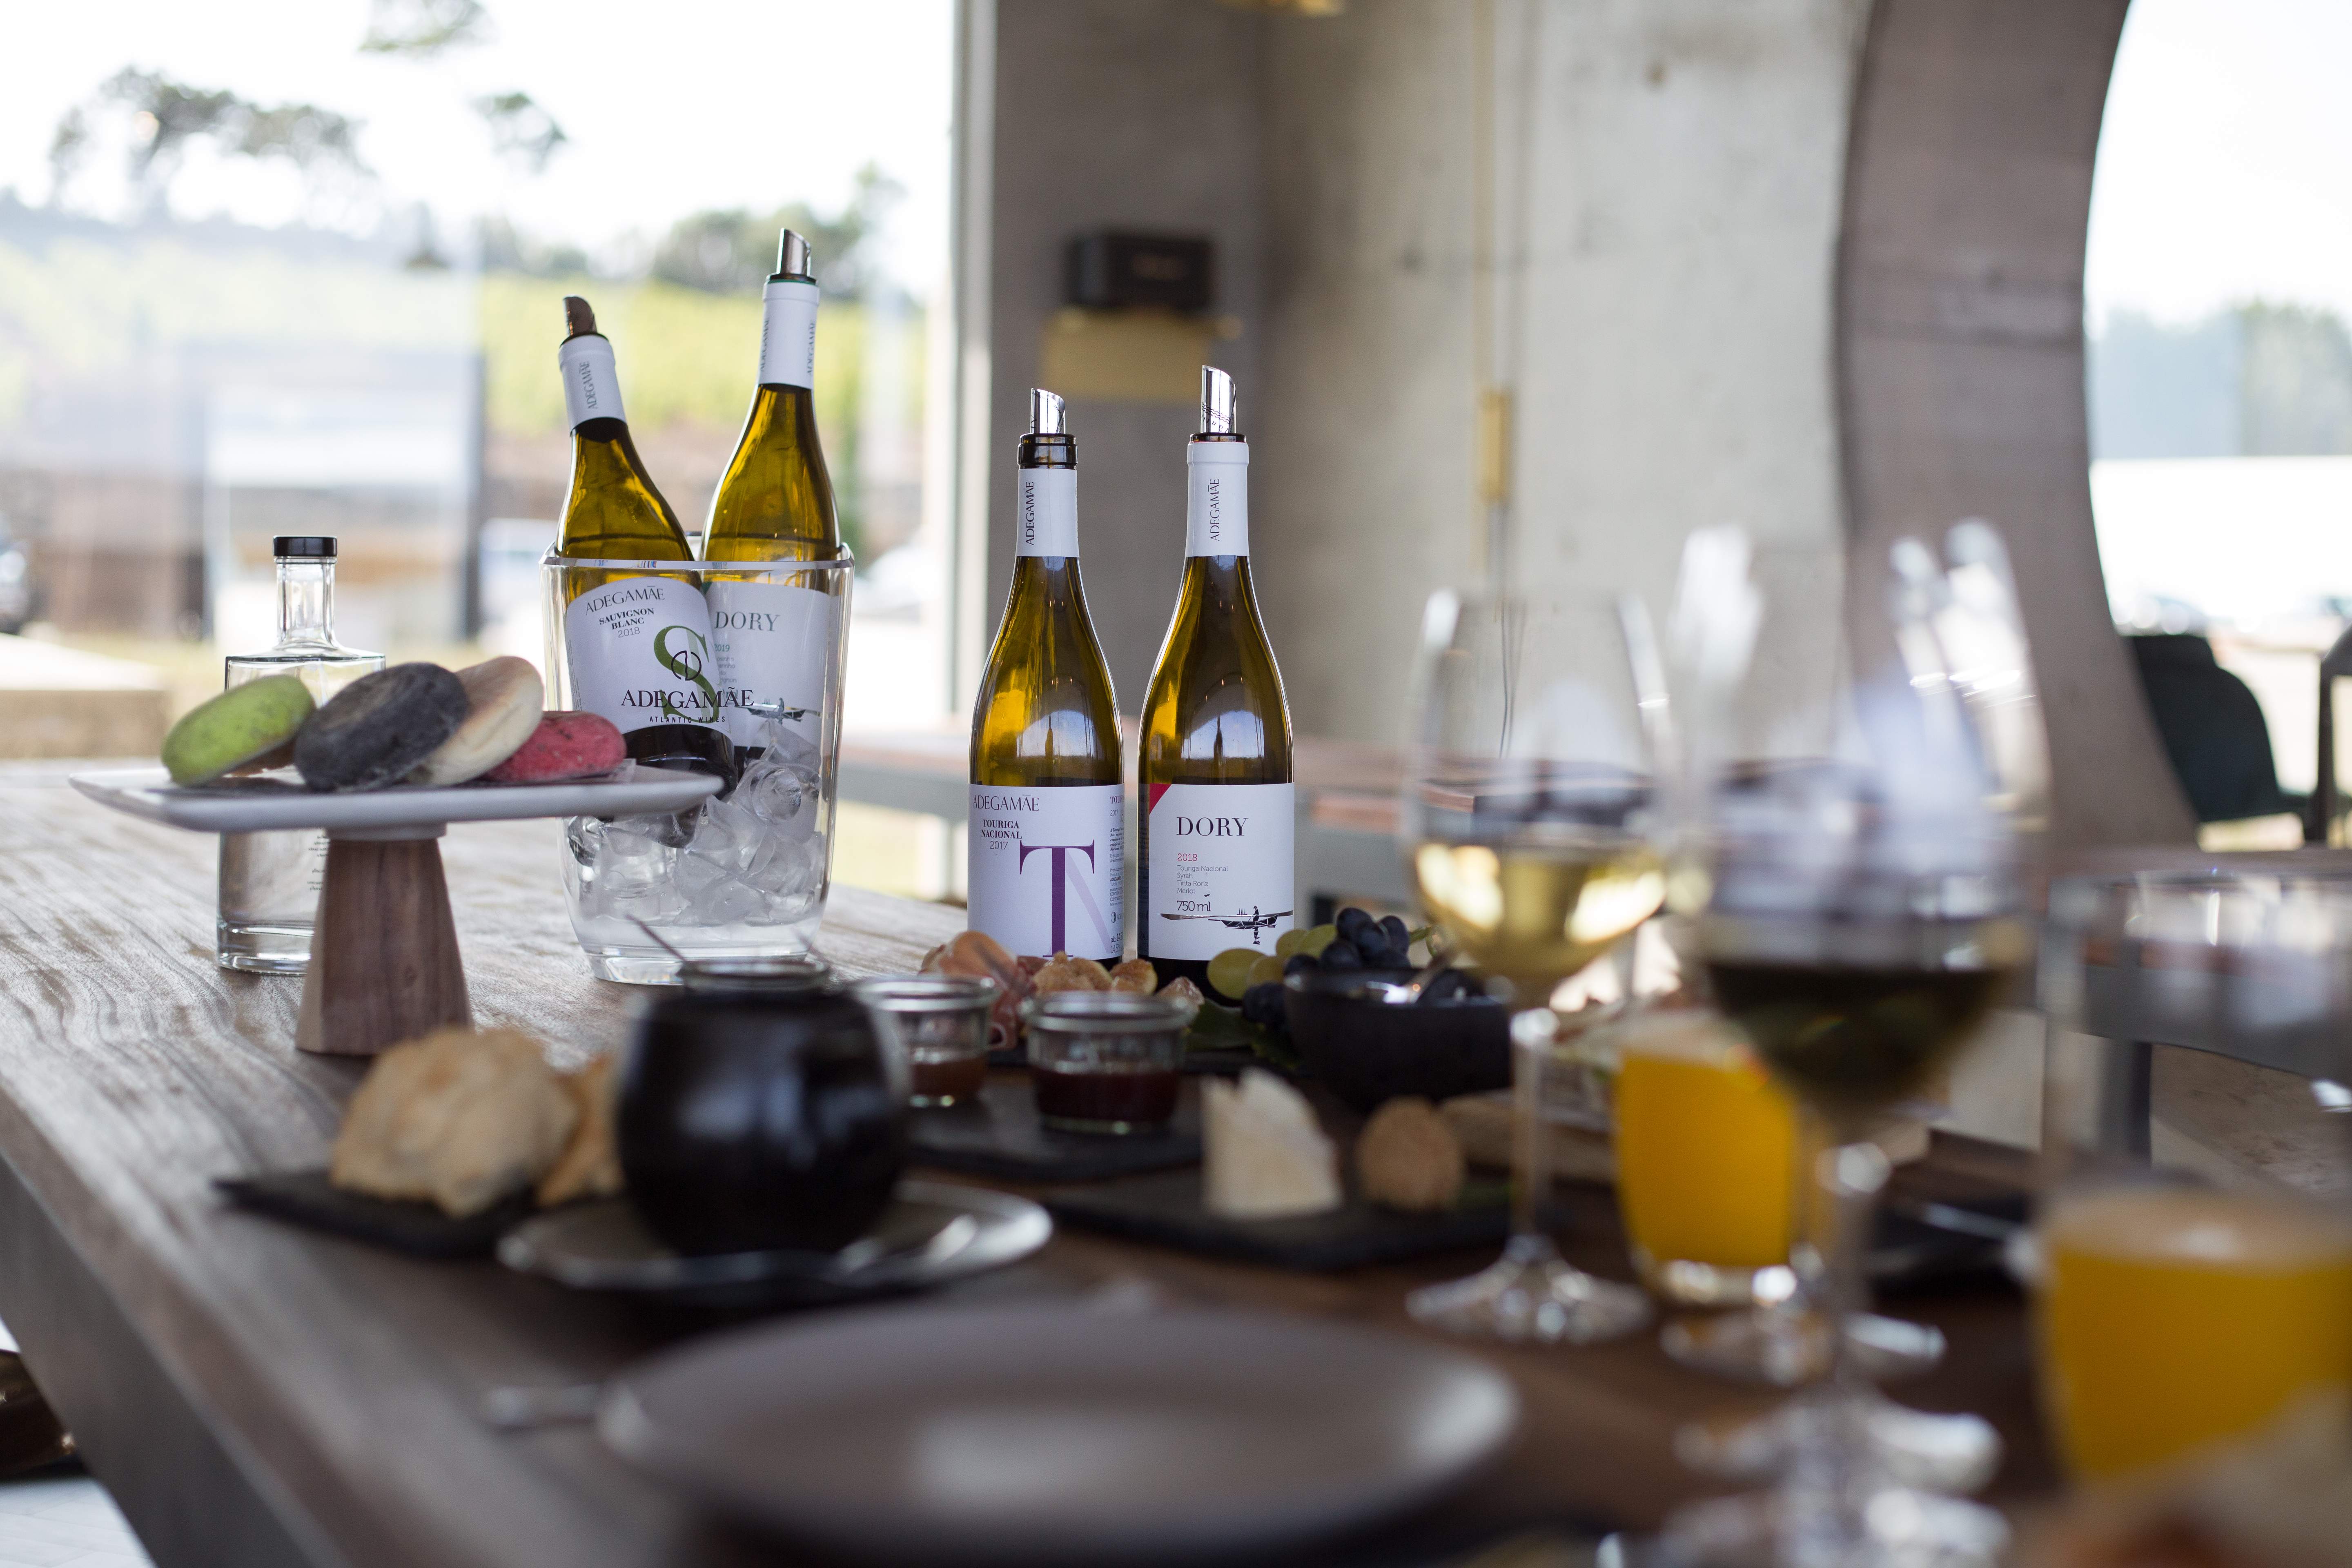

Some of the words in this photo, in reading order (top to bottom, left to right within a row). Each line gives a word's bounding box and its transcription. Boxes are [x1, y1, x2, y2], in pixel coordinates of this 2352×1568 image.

[599, 608, 654, 625] SAUVIGNON
[715, 611, 780, 631] DORY
[612, 617, 644, 630] BLANC
[618, 627, 640, 638] 2018
[621, 687, 754, 708] ADEGAMÃE
[982, 819, 1020, 829] TOURIGA
[1176, 817, 1249, 836] DORY
[981, 829, 1022, 839] NACIONAL
[990, 840, 1008, 849] 2017
[1177, 853, 1198, 861] 2018
[1177, 900, 1195, 911] 750
[1197, 901, 1211, 911] ml
